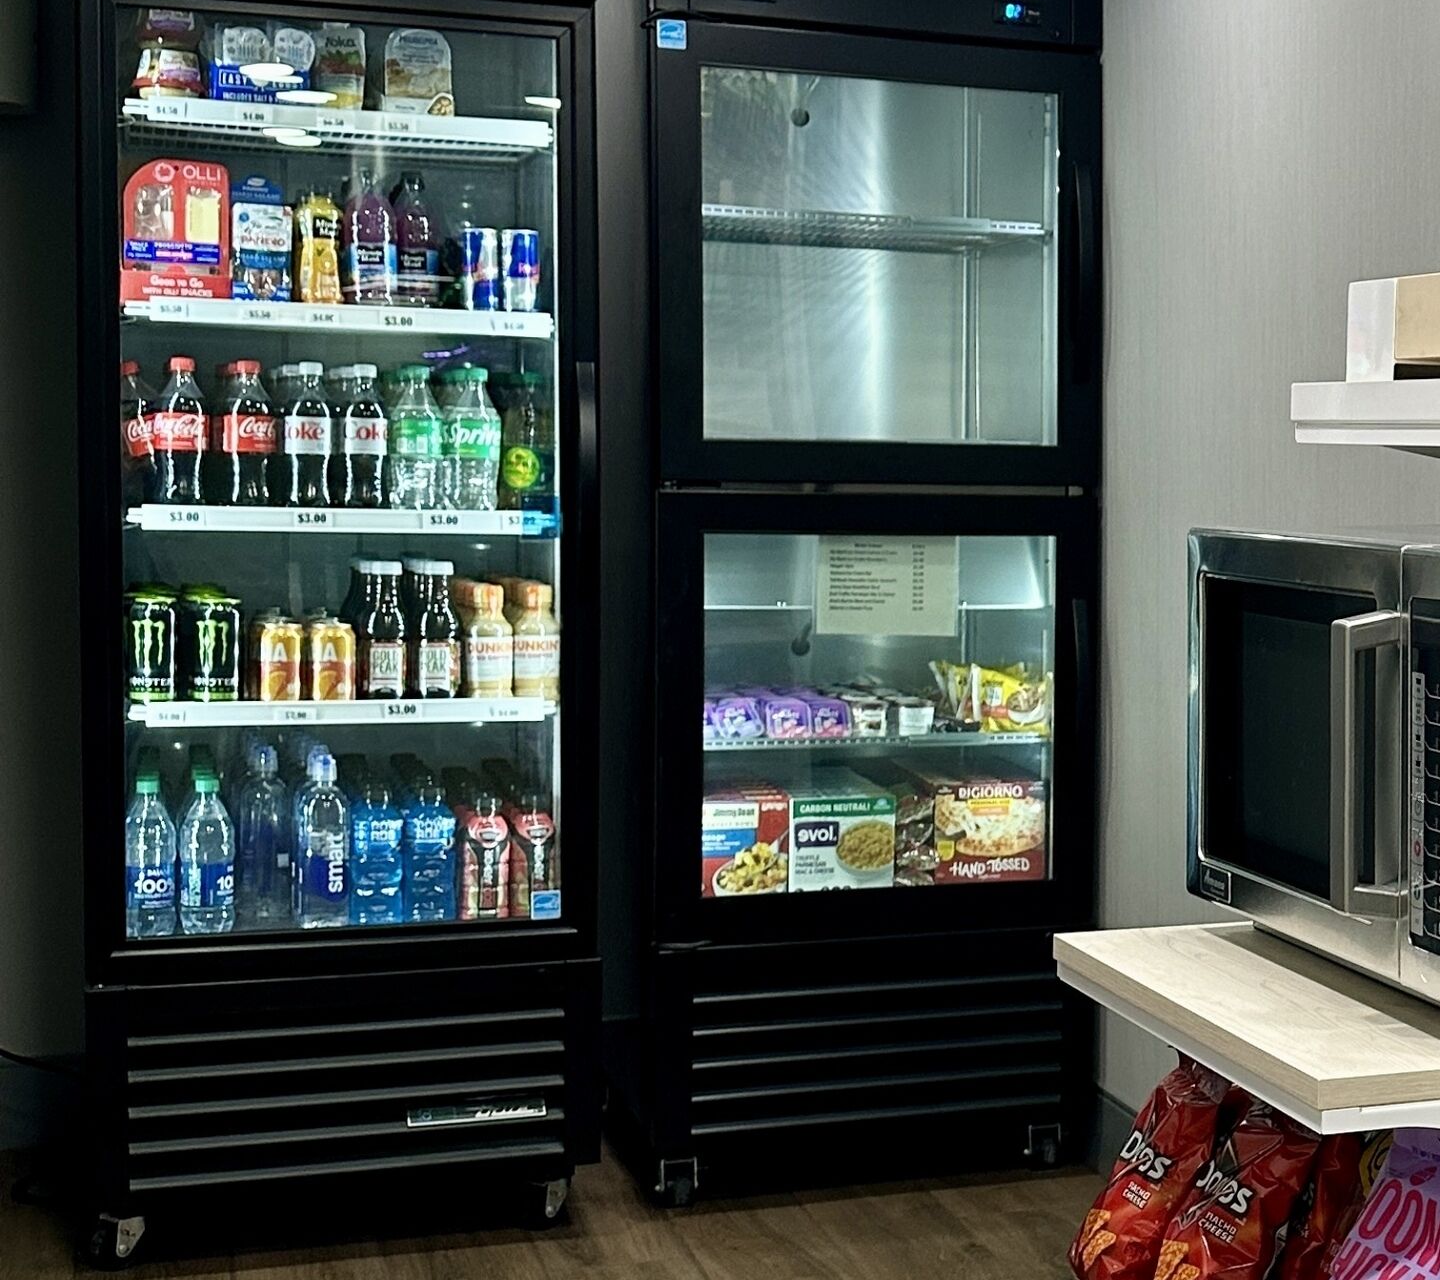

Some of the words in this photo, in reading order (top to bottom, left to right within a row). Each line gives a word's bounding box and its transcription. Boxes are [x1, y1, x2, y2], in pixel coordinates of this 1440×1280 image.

[182, 164, 222, 182] OLLI
[384, 316, 413, 327] $3.00
[169, 511, 200, 522] $3.00
[297, 513, 327, 524] $3.00
[430, 516, 459, 526] $3.00
[387, 705, 417, 715] $3.00
[958, 785, 1024, 799] DIGIORNO
[799, 803, 832, 814] CARBON
[833, 801, 871, 813] NEUTRAL!
[1128, 1181, 1152, 1200] NACHO
[1122, 1188, 1147, 1209] CHEESE
[1205, 1211, 1238, 1236] NACHO
[1198, 1218, 1235, 1244] CHEESE
